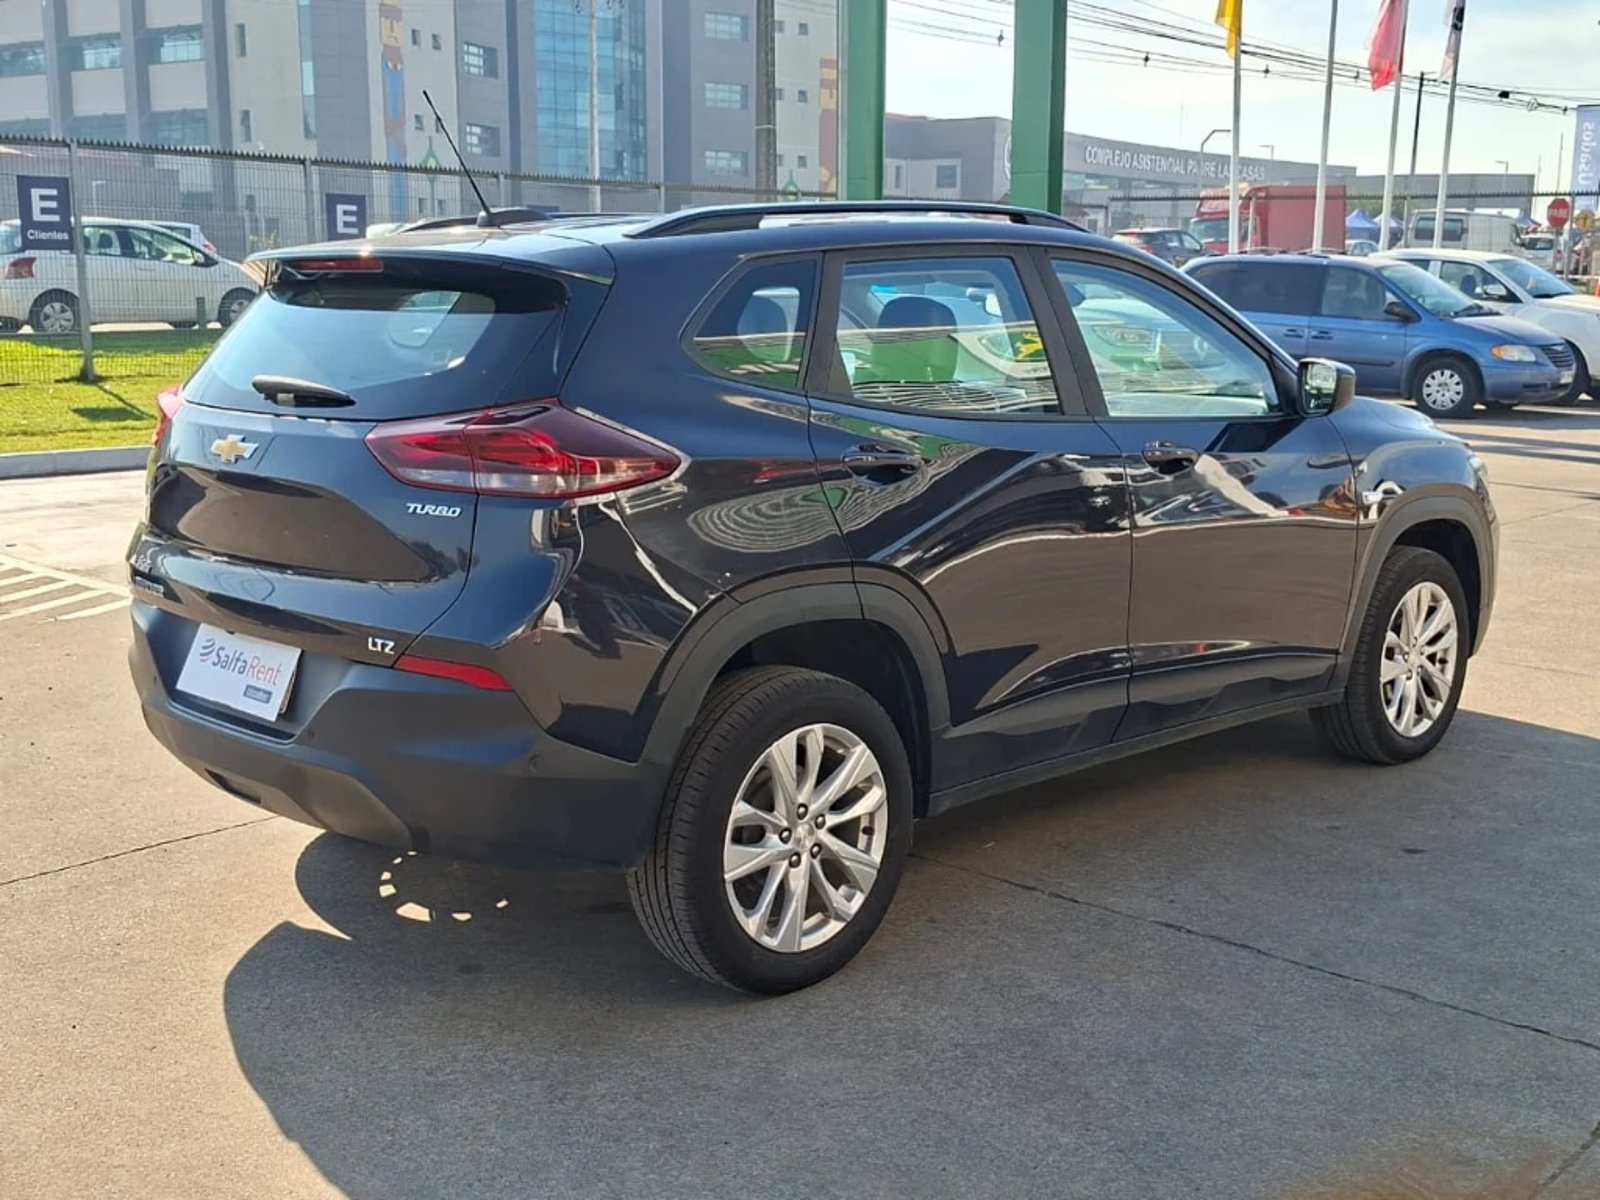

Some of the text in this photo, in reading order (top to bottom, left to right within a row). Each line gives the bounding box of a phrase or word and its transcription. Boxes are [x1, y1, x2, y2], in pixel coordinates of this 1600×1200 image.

[1085, 145, 1131, 169] COMPLEJO
[1131, 152, 1186, 175] ASISTENCIAL
[1218, 162, 1231, 178] LA
[1239, 164, 1266, 181] ASAS
[30, 187, 60, 222] E
[336, 203, 359, 234] E
[27, 228, 69, 241] Clientes
[406, 502, 463, 518] TURBO
[367, 636, 396, 655] LTZ
